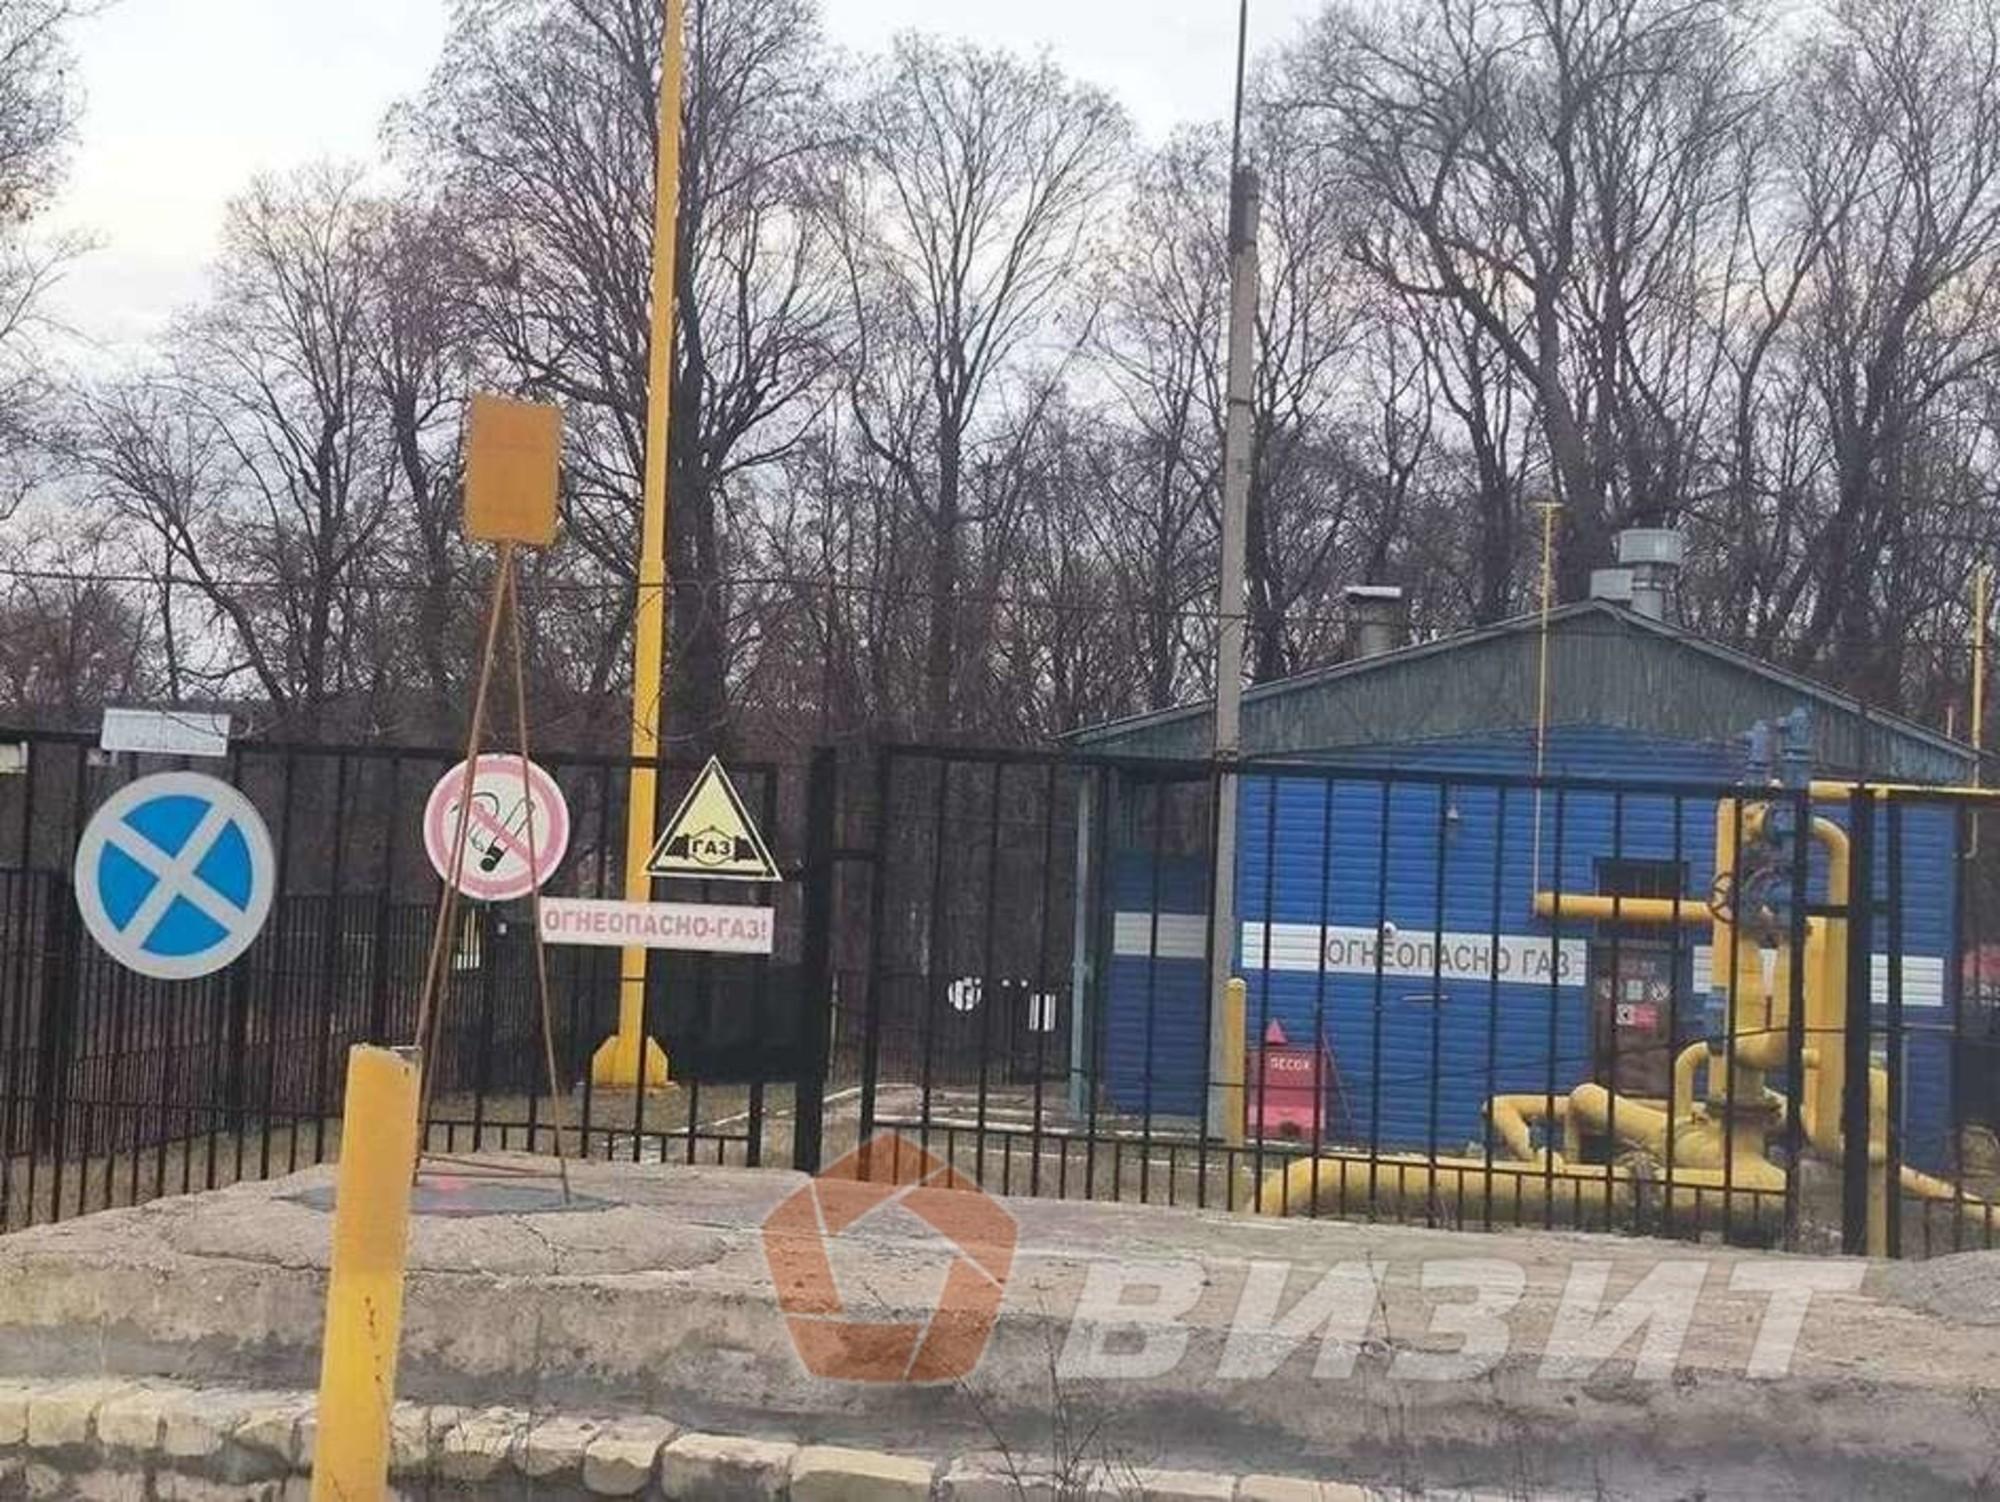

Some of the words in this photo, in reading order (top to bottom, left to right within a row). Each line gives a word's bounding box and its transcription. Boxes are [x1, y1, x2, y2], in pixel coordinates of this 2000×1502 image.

[692, 840, 730, 855] ГАЗ
[544, 909, 767, 940] ОГНЕОПАСНО-ГАЗ!
[1522, 949, 1569, 977] ГАЗ
